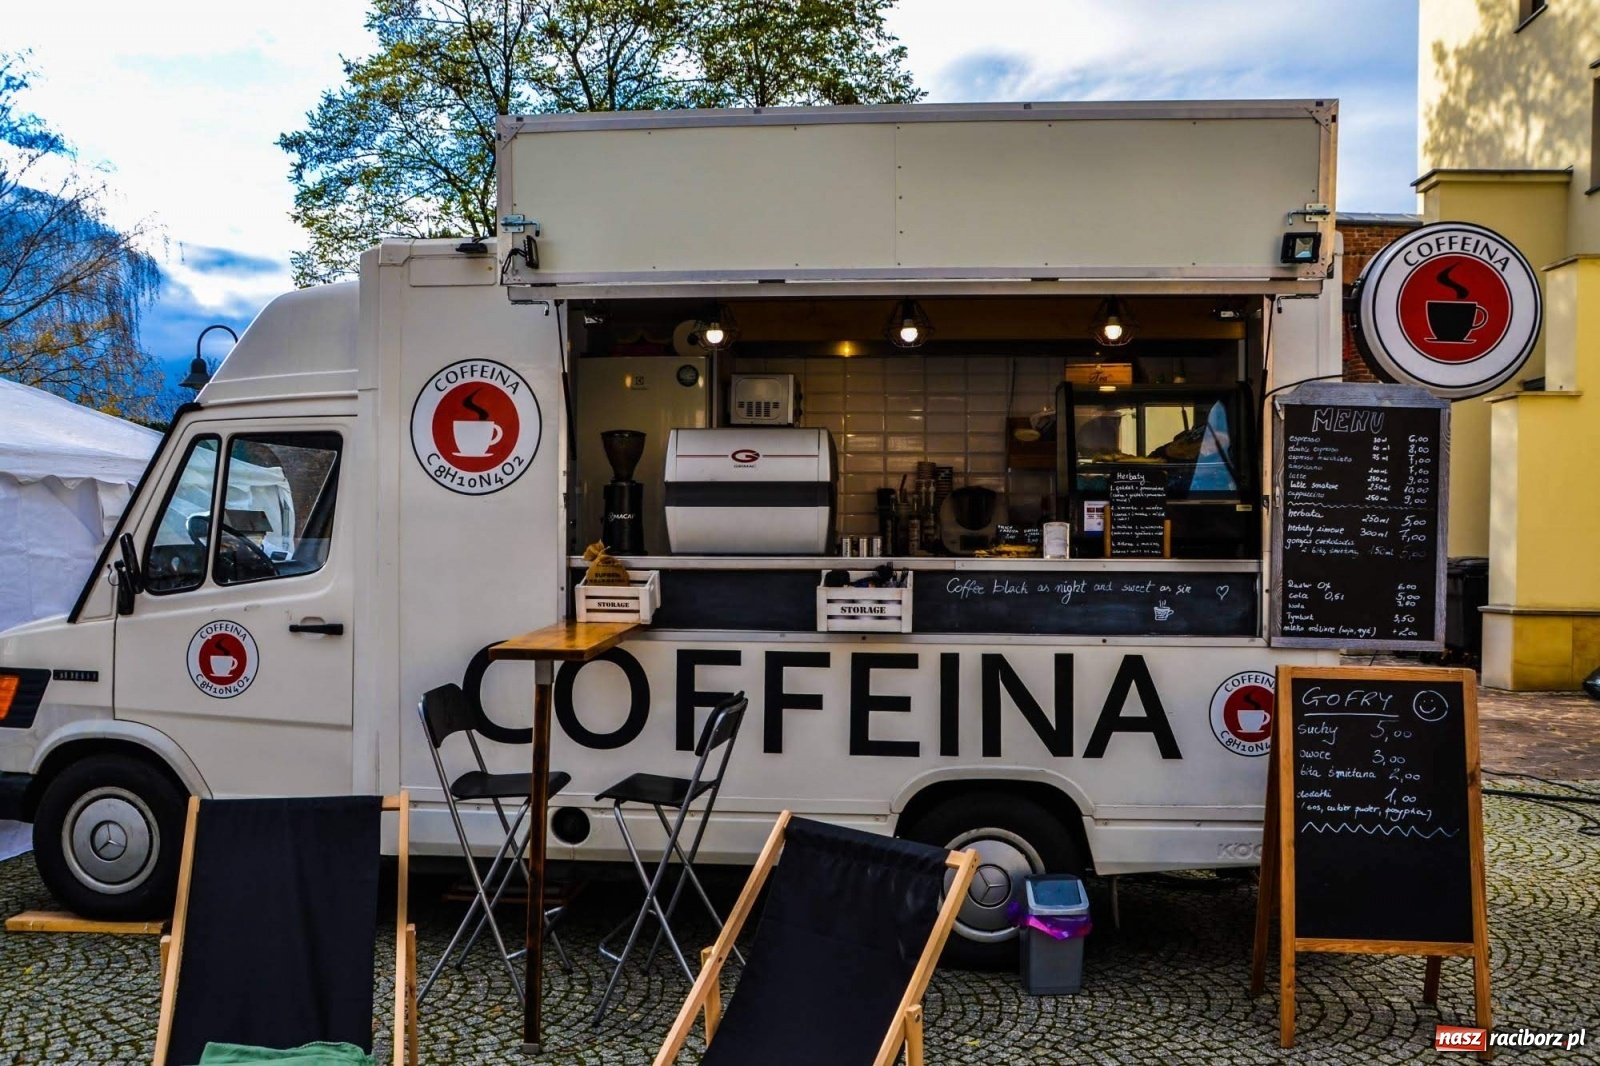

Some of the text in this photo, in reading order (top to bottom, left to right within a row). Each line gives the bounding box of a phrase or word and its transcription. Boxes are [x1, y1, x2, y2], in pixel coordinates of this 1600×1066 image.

[1403, 235, 1511, 272] COFFEINA
[434, 364, 520, 395] COFFEINA
[1312, 408, 1385, 434] MENU
[1288, 435, 1321, 445] espresso
[1408, 444, 1430, 455] 8,00
[427, 452, 525, 488] C8H10N4O2
[1116, 472, 1146, 486] Herbaty
[1407, 475, 1429, 486] 9,00
[1404, 485, 1429, 495] 10,00
[1403, 494, 1427, 505] 9,00
[1288, 508, 1324, 519] herbata
[1401, 515, 1427, 527] 5,00
[1398, 528, 1426, 542] 7,00
[946, 577, 985, 599] Coffee
[992, 579, 1028, 595] black
[1037, 583, 1050, 593] as
[1054, 578, 1087, 605] night
[1093, 579, 1113, 593] and
[1121, 580, 1156, 594] sweet
[1159, 584, 1172, 593] as
[1395, 591, 1420, 601] 5,00
[597, 601, 630, 609] STORAGE
[840, 605, 887, 615] STORAGE
[200, 623, 247, 642] COFFEINA
[195, 673, 250, 694] C8H10N4O2
[1224, 674, 1275, 692] COFFEIN
[461, 642, 1183, 760] COFFEINA
[1302, 686, 1393, 710] GOFRY
[1370, 719, 1413, 742] 5,00
[1371, 749, 1406, 766] 3,00
[1388, 767, 1421, 783] 2,00
[1296, 787, 1417, 805] dodatki 1,00
